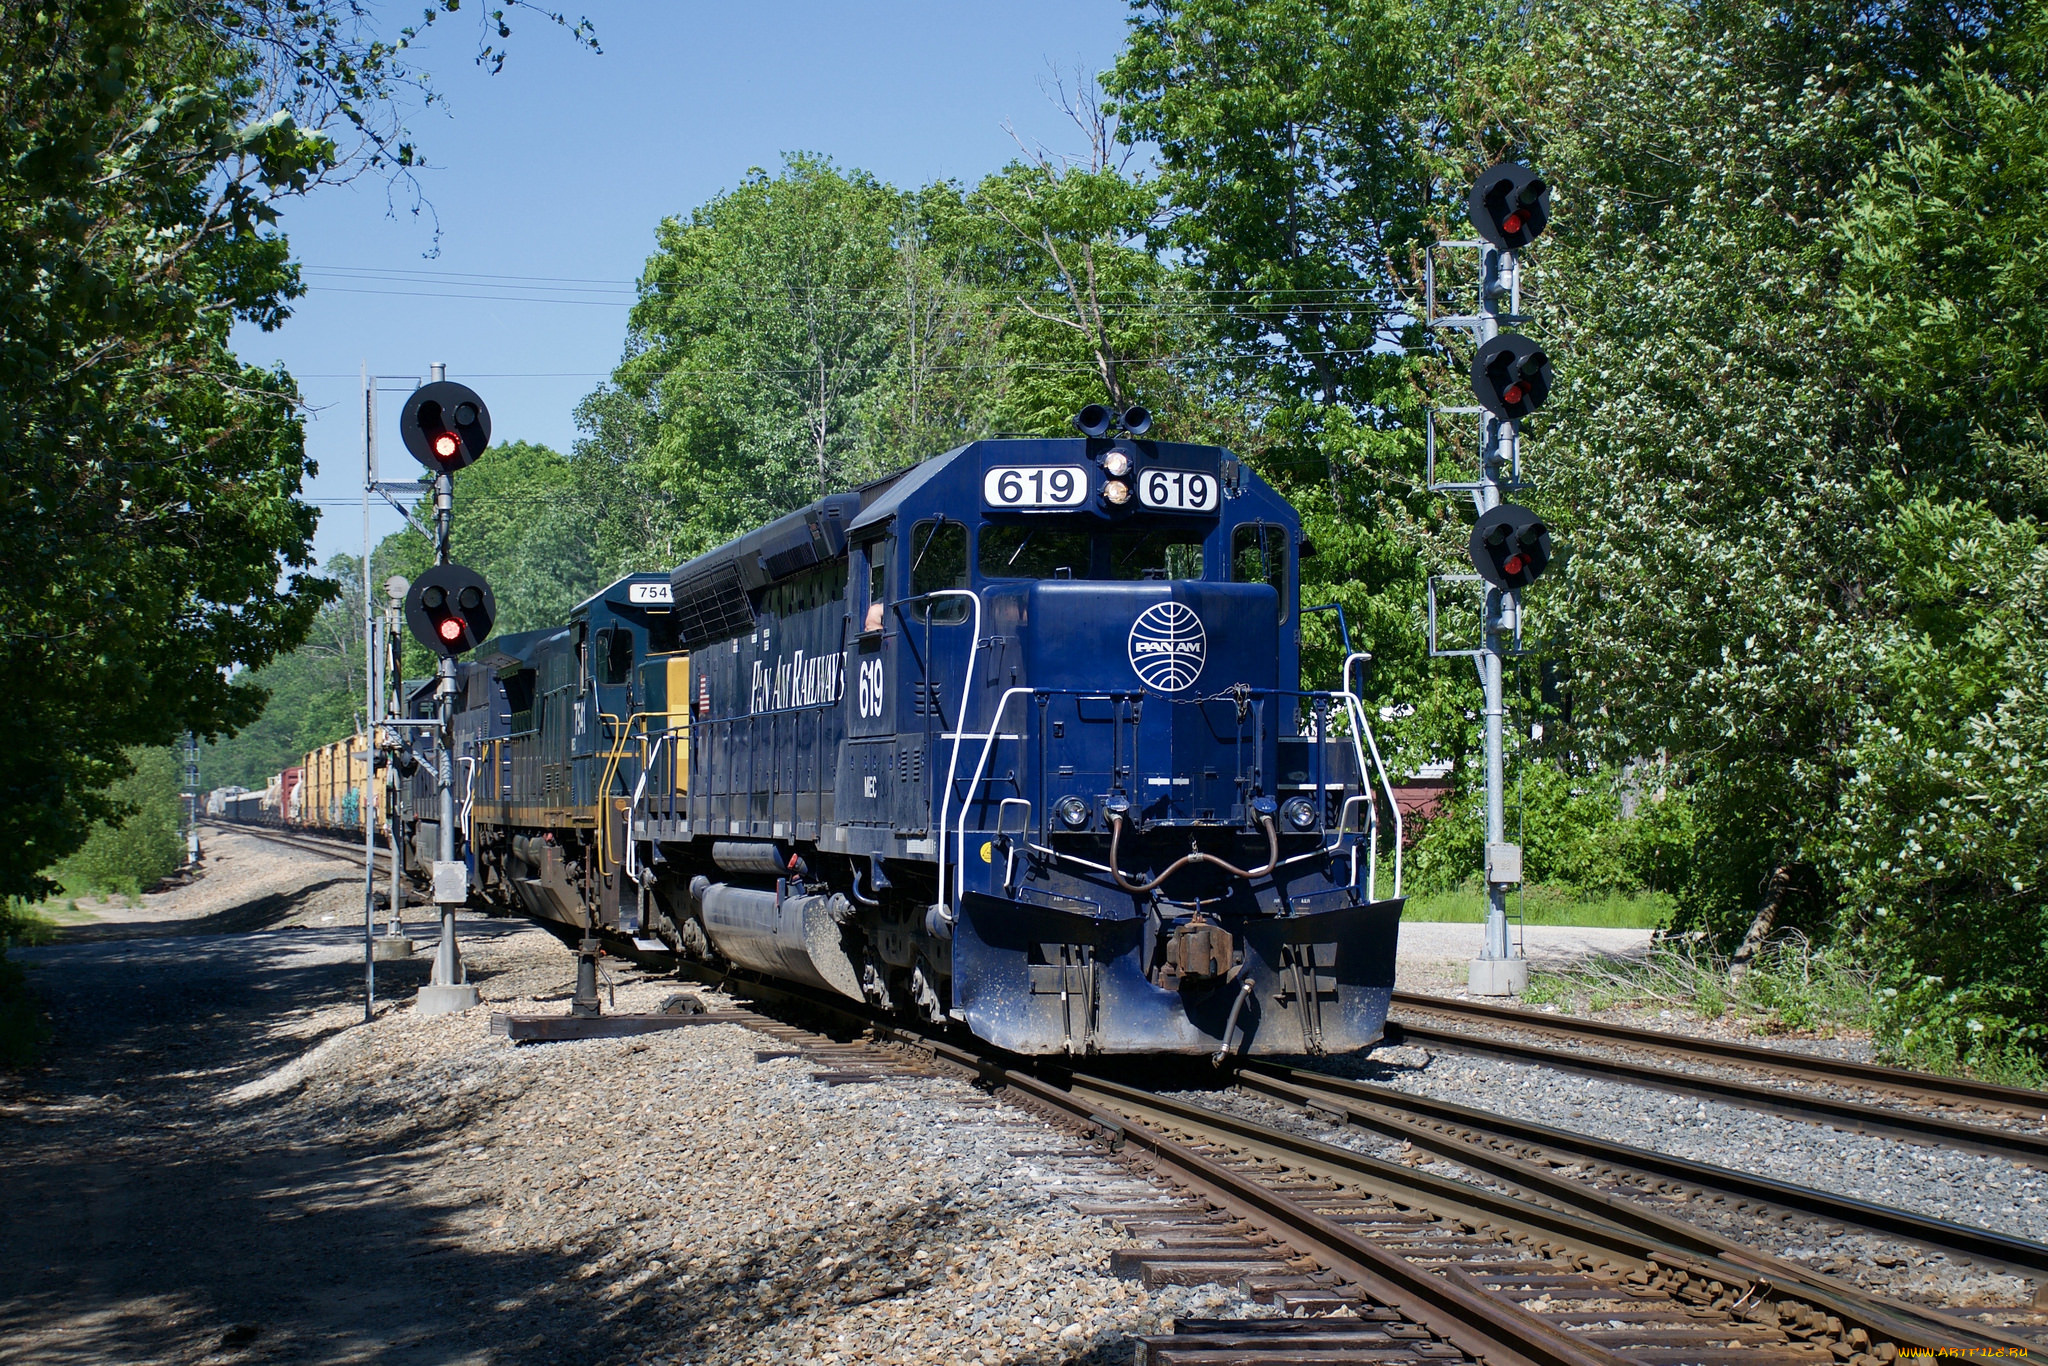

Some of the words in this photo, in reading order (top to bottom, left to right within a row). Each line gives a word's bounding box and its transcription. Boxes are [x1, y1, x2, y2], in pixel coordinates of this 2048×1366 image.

[997, 469, 1075, 504] 619
[1148, 472, 1208, 508] 619
[640, 587, 674, 598] 754
[1135, 641, 1175, 653] PAN
[1175, 642, 1201, 653] AM
[750, 659, 773, 714] PAN
[771, 654, 792, 710] AM
[791, 649, 848, 708] RAILWAYS
[859, 658, 883, 719] 619
[864, 775, 878, 798] MEC
